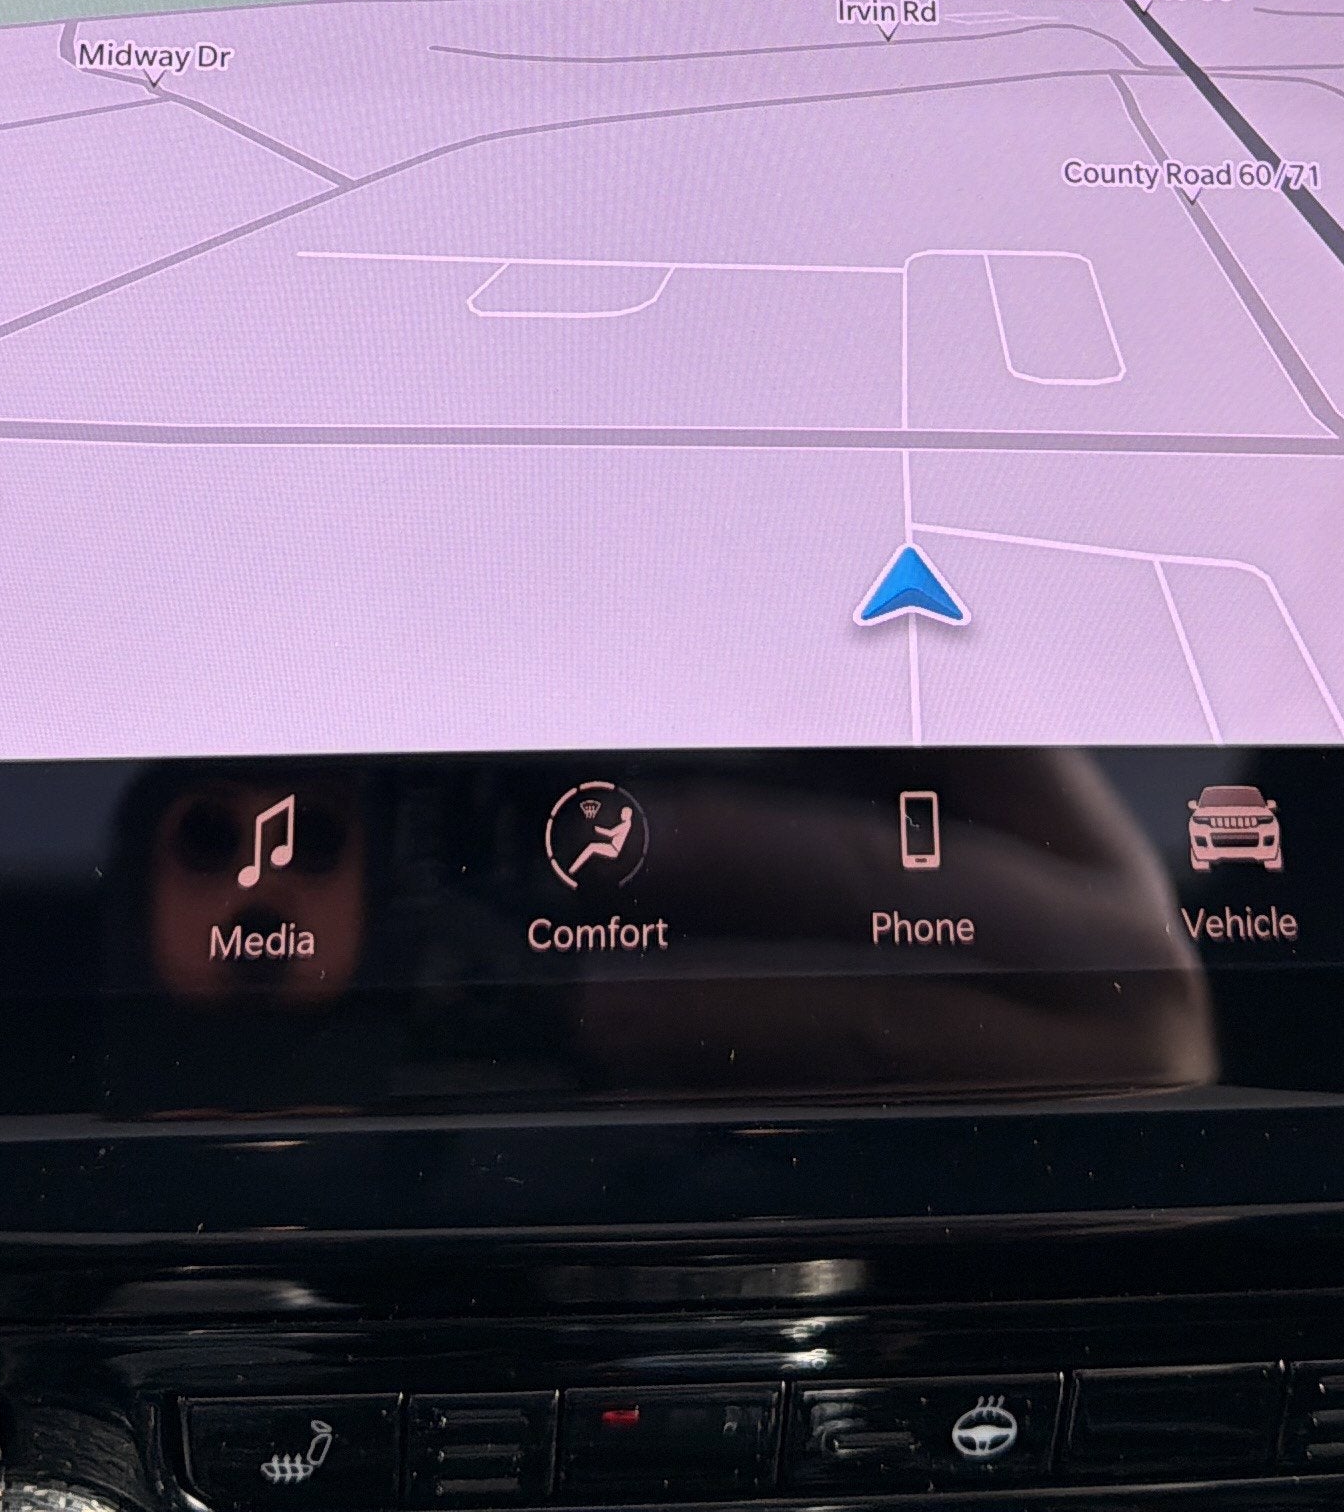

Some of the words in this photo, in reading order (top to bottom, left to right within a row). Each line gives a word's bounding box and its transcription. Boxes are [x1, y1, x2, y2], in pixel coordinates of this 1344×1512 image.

[836, 0, 897, 24] Irvin
[902, 0, 938, 24] Rd
[78, 42, 190, 72] Midway
[196, 44, 233, 69] Dr
[1063, 161, 1159, 190] County
[1166, 162, 1232, 187] Road
[1238, 163, 1320, 189] 60/71
[527, 916, 668, 952] Comfort
[869, 911, 976, 946] Phone
[1182, 906, 1299, 941] Vehicle
[208, 922, 317, 961] Media
